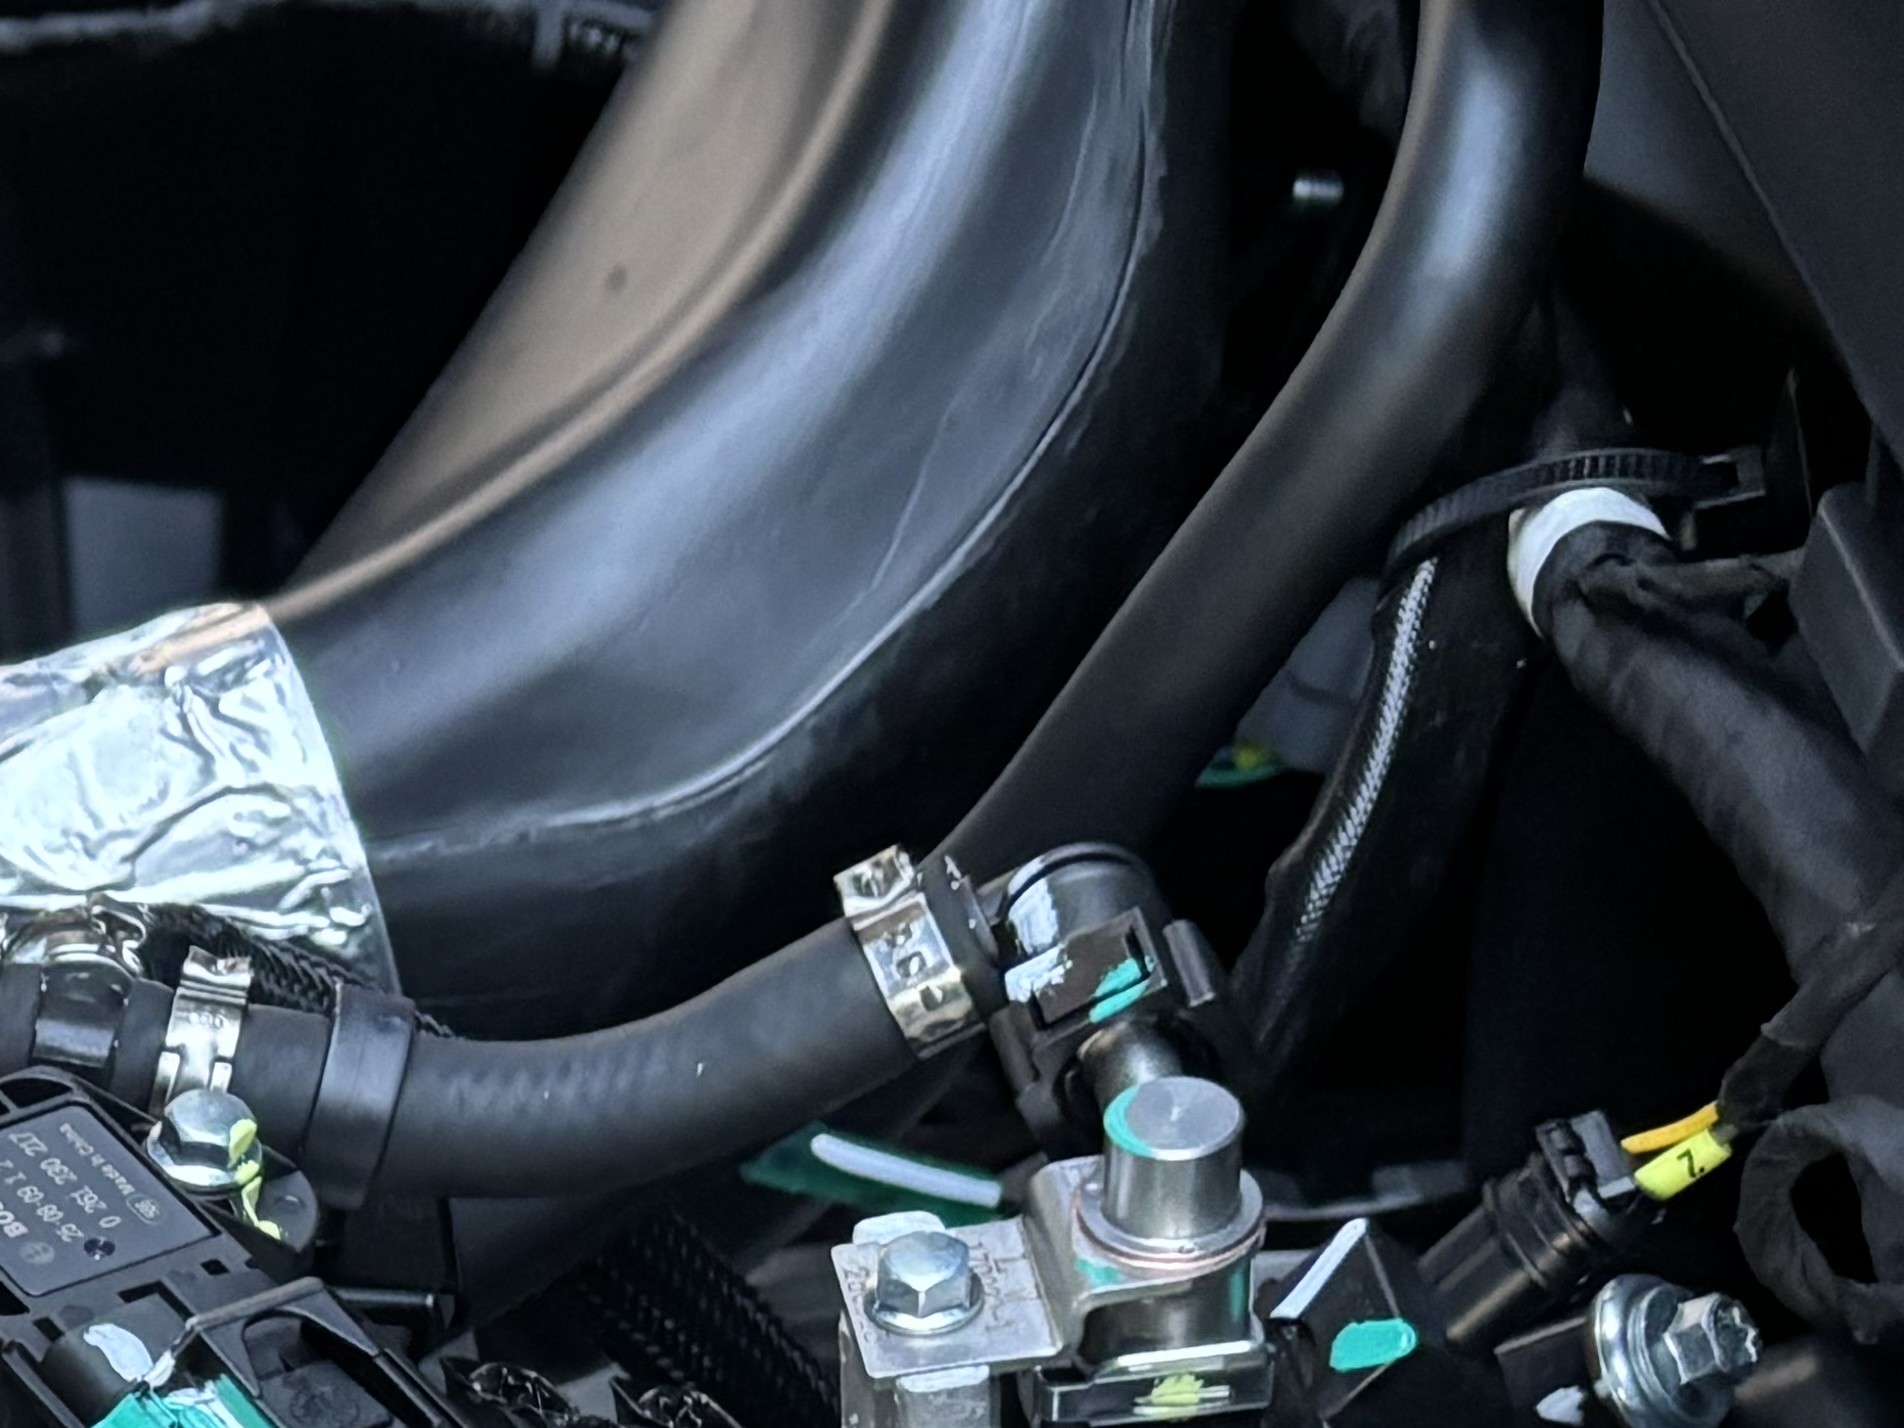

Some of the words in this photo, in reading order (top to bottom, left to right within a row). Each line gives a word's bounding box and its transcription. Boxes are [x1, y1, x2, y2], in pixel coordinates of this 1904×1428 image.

[58, 1121, 95, 1157] China
[38, 1156, 78, 1185] 230
[90, 1153, 105, 1167] in
[100, 1163, 136, 1196] Made
